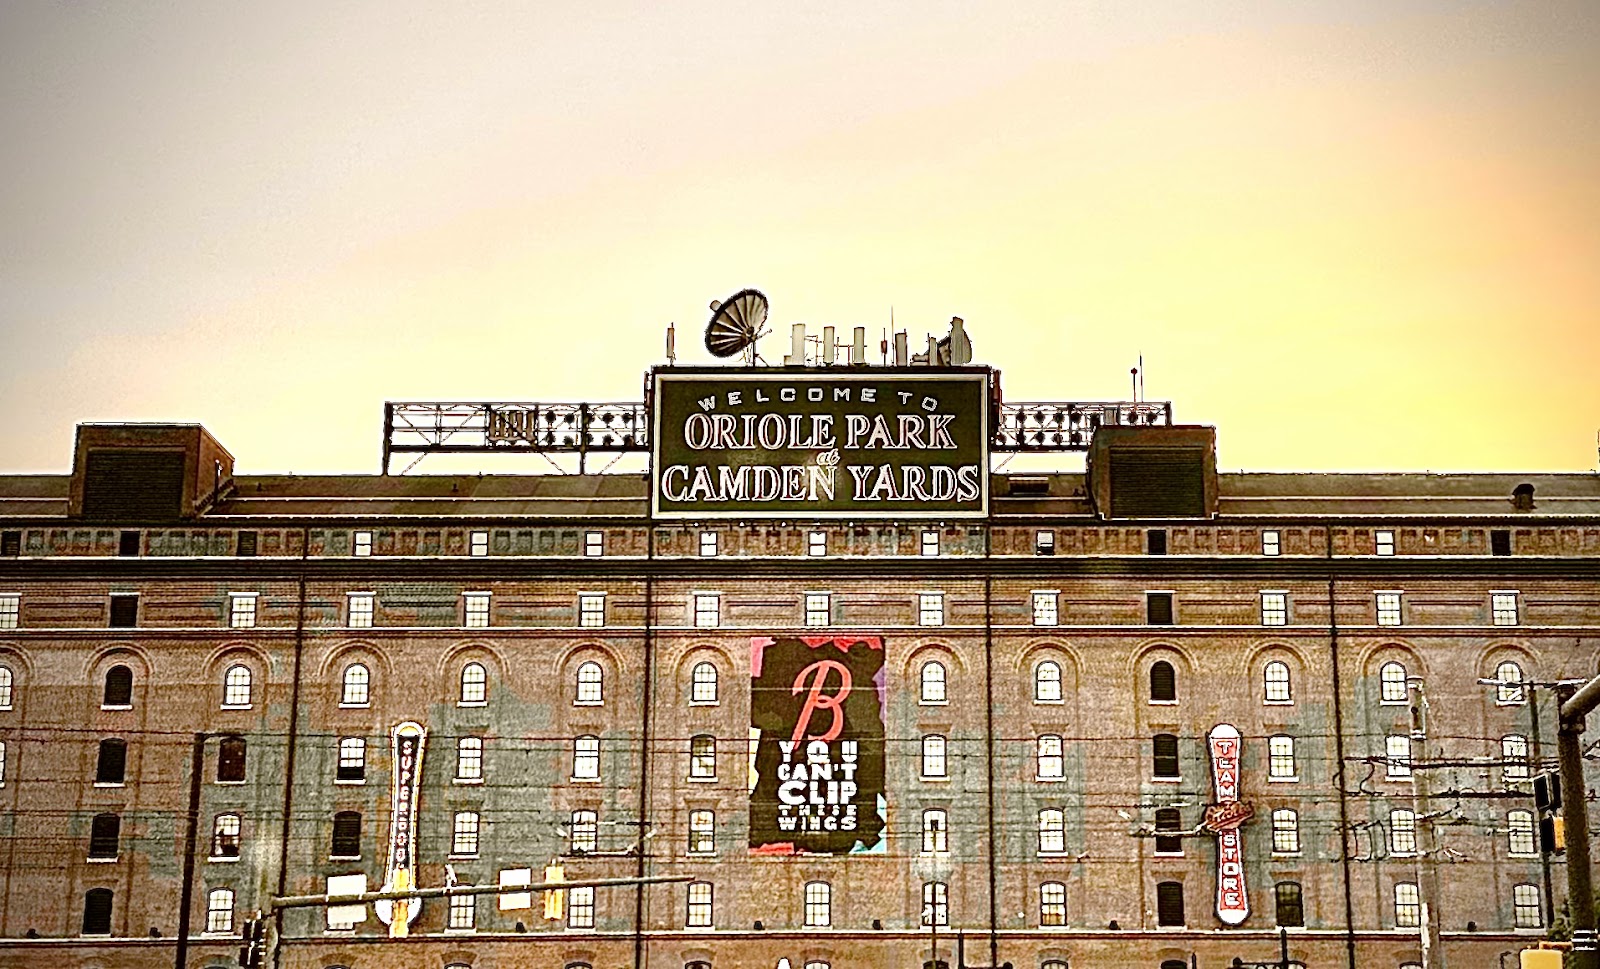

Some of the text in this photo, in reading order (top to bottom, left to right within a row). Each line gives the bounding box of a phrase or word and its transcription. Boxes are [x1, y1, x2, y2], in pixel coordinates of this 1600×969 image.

[697, 387, 938, 412] WELCOME TO
[684, 414, 957, 450] ORIOLE PARK
[816, 448, 841, 466] at
[661, 464, 980, 503] CAMDEN YARDS
[792, 659, 852, 750] B
[778, 740, 858, 763] YOU
[777, 763, 858, 781] CAN'T
[1216, 740, 1235, 797] TEAM
[777, 780, 858, 805] CLIP
[778, 804, 858, 816] THESE
[778, 816, 858, 831] WINGS
[1223, 833, 1240, 906] STORE
